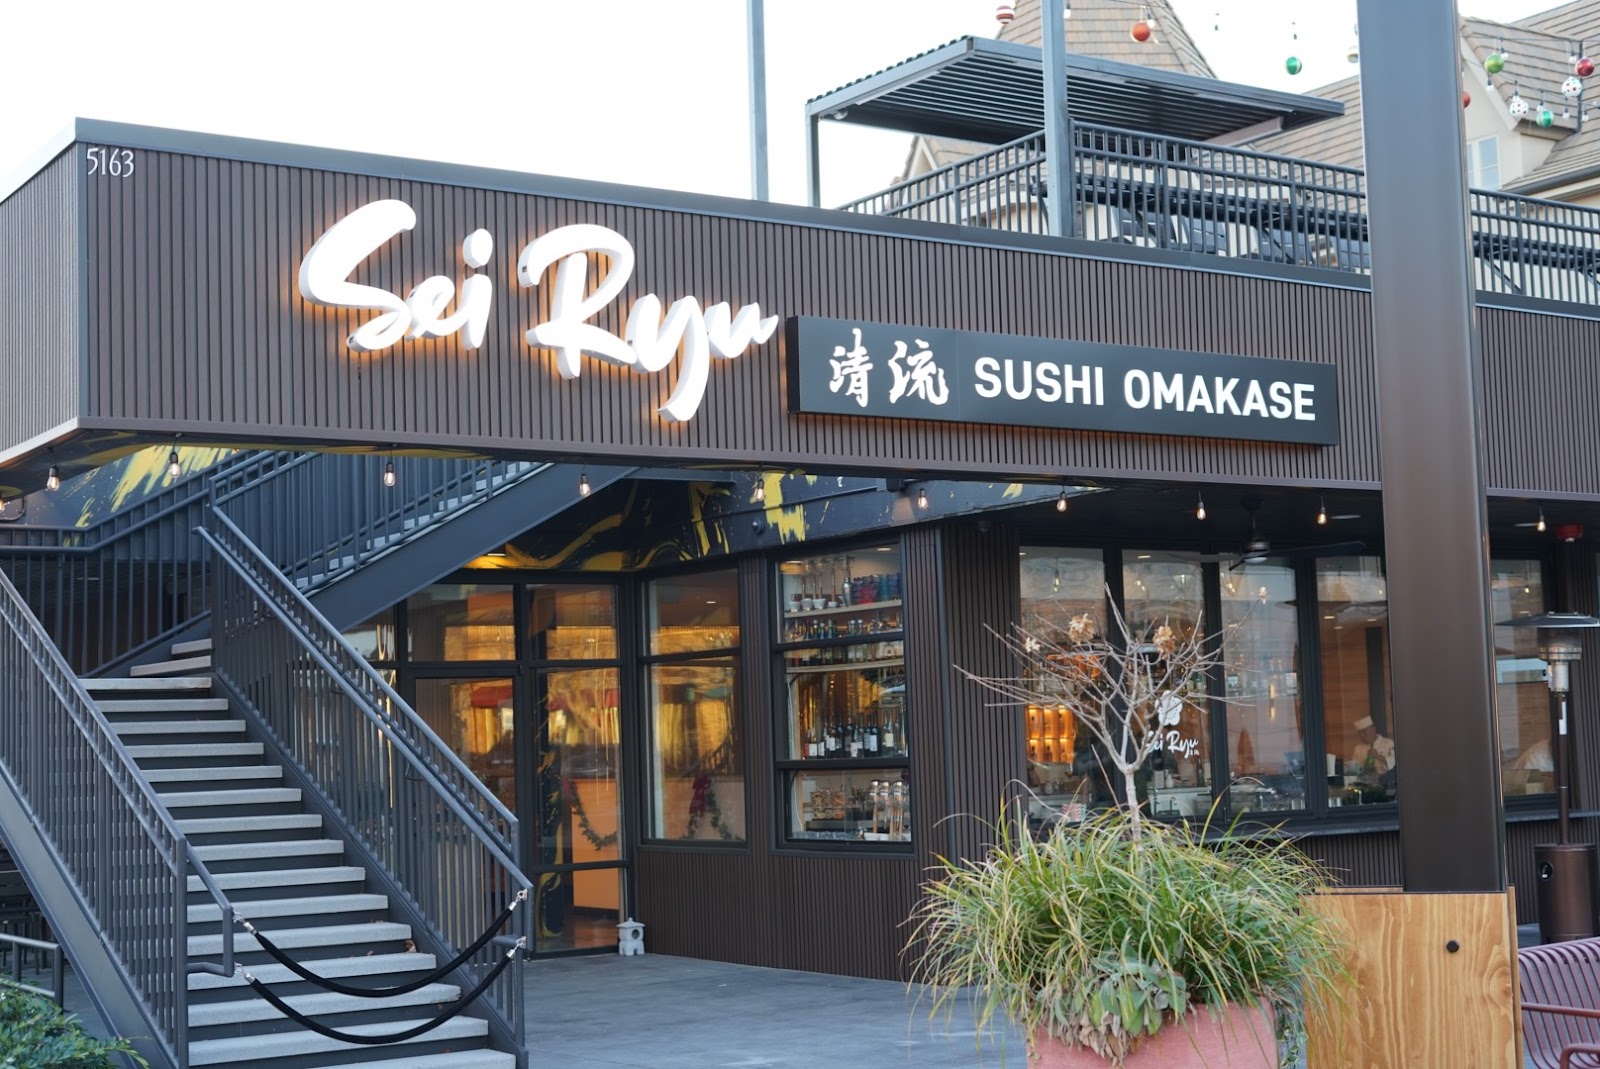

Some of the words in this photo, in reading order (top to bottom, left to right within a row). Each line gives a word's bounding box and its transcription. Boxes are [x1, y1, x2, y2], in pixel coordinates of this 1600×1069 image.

[86, 147, 135, 178] 5163
[298, 198, 494, 353] Sei
[517, 223, 779, 423] Ryu
[828, 328, 950, 407] 清流
[974, 356, 1105, 406] SUSHI
[1123, 369, 1317, 421] OMAKASE
[1166, 730, 1199, 758] Ryu
